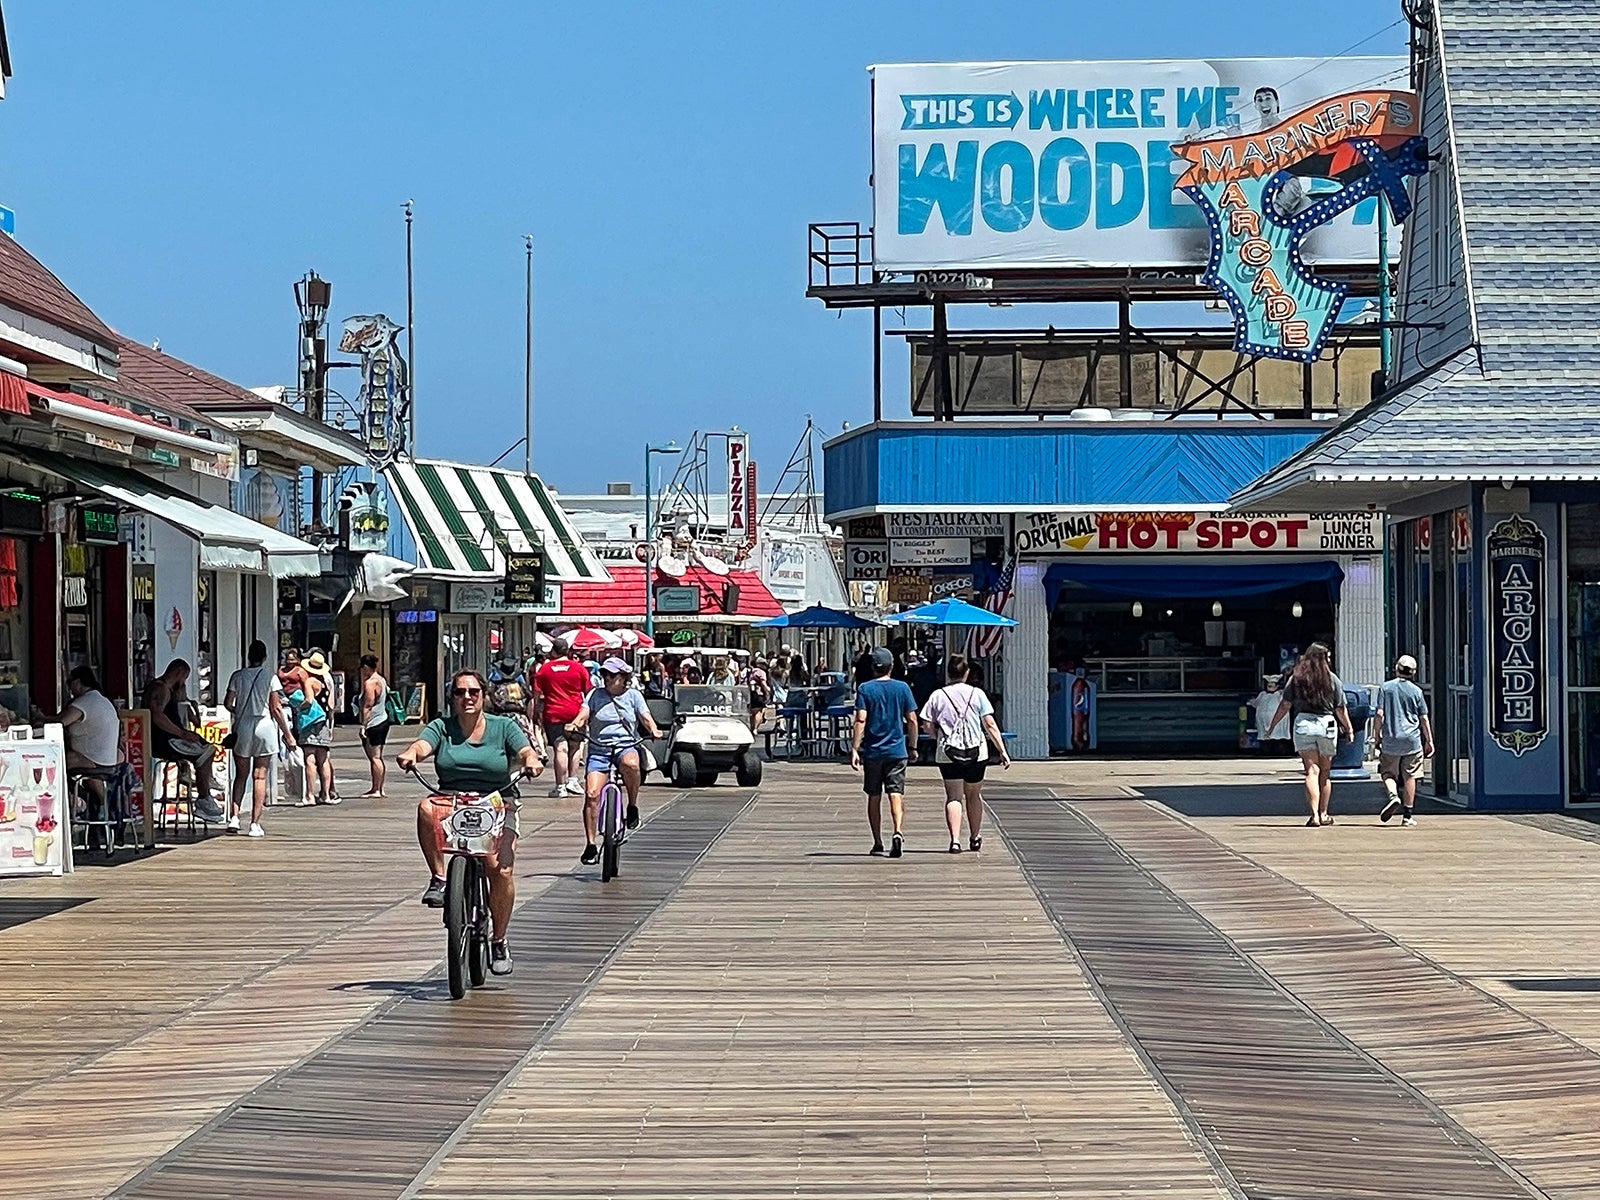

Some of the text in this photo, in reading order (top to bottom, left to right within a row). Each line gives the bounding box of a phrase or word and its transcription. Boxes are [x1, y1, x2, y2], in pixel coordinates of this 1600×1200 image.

[912, 86, 1241, 130] THIS IS WHERE WE
[1202, 95, 1415, 172] MARINER'S
[898, 137, 1197, 237] WOODE
[1220, 182, 1310, 348] ARCADE
[730, 442, 743, 529] PIZZA
[890, 513, 1002, 526] RESTAURANT
[1025, 512, 1058, 527] THE
[1323, 521, 1371, 535] LUNCH
[905, 526, 955, 536] CONDITIONED
[956, 526, 982, 537] DINING
[1016, 514, 1308, 551] ORIGINAL HOT SPOT
[1320, 535, 1375, 549] DINNER
[853, 567, 882, 578] HOT
[934, 578, 972, 595] OREOS
[1501, 563, 1535, 722] ARCADE
[693, 705, 733, 714] POLICE
